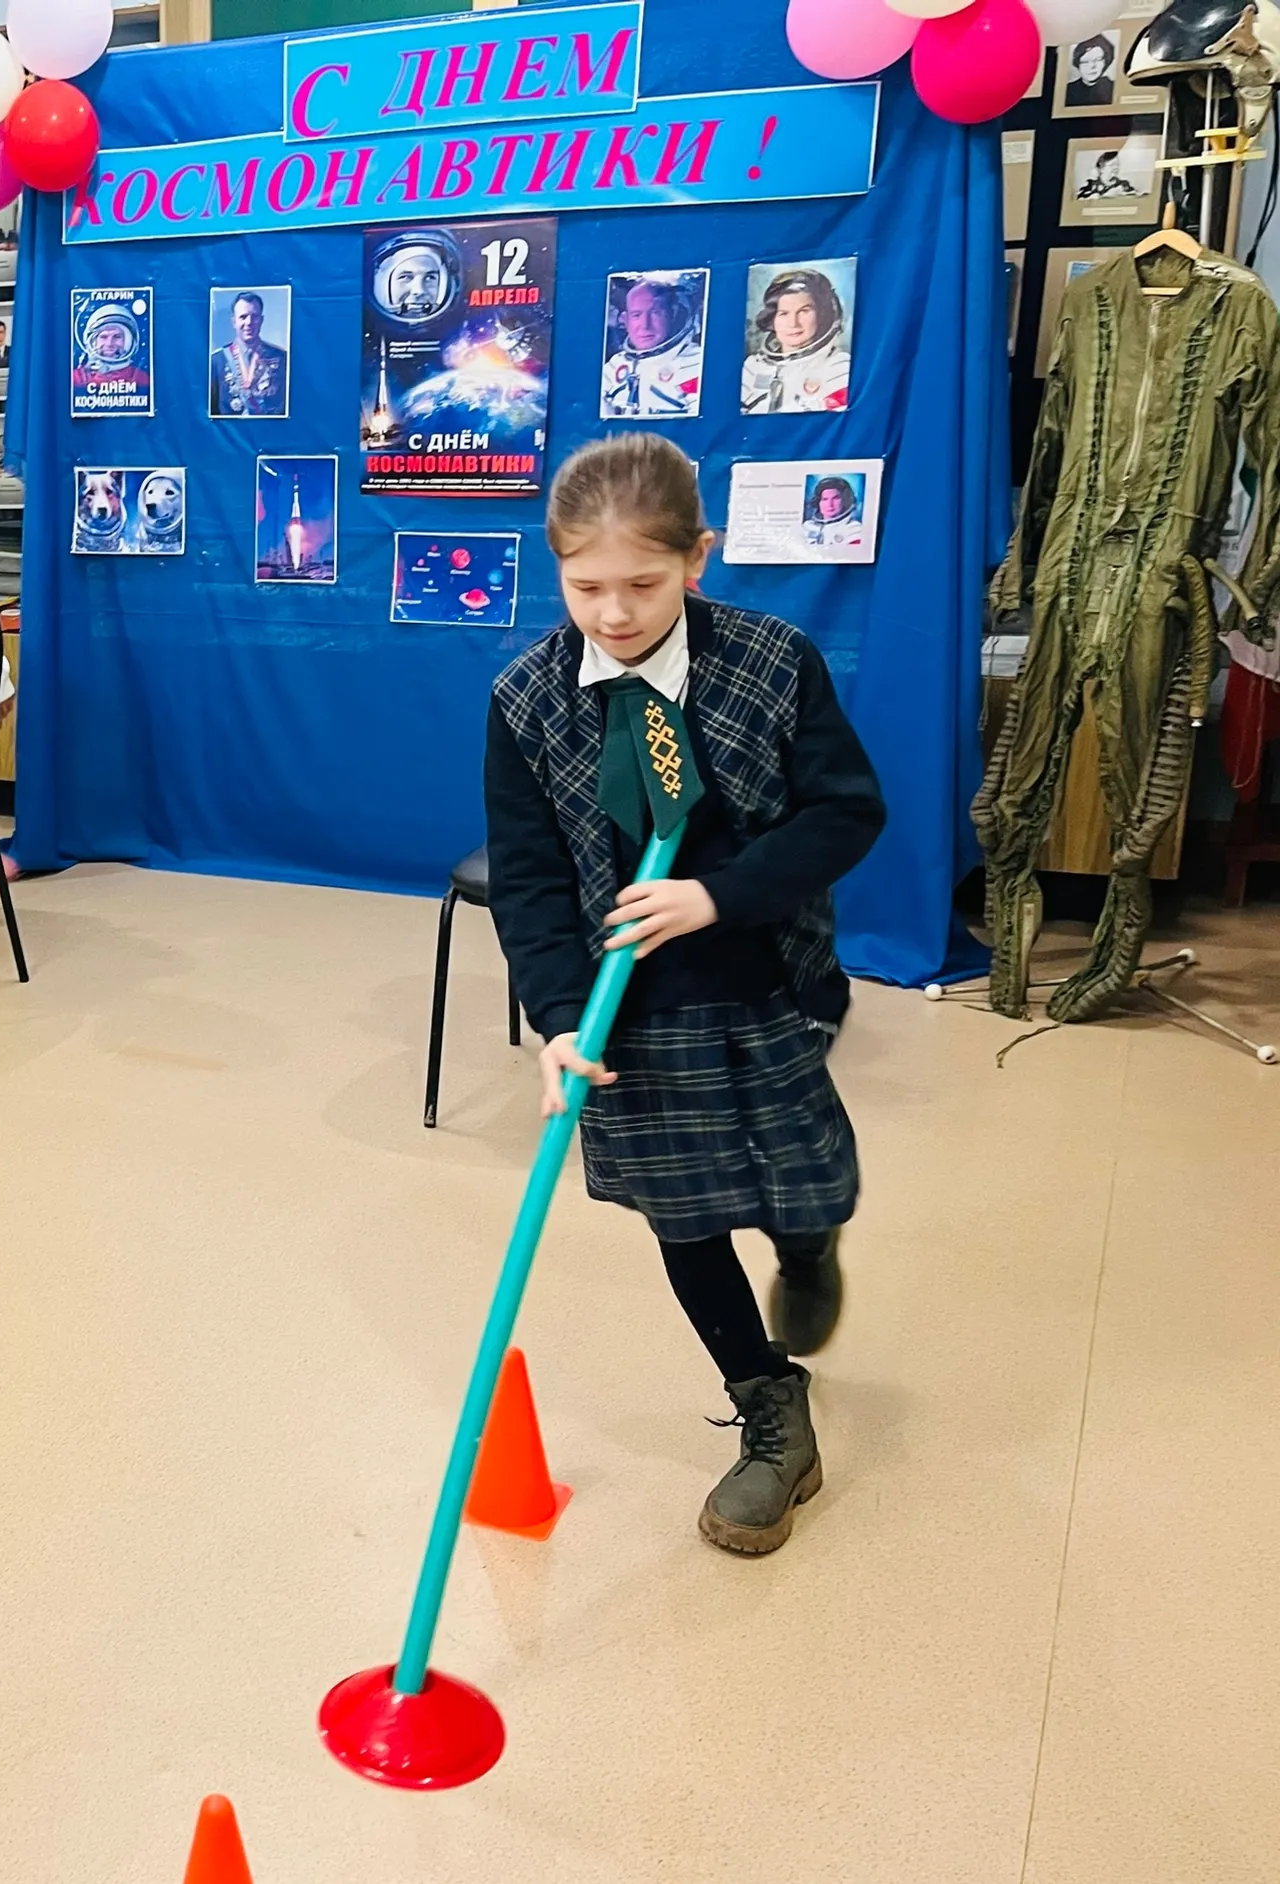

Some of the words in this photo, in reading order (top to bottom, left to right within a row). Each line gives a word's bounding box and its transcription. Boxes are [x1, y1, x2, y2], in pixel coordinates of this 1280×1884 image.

[291, 64, 350, 139] С
[379, 28, 638, 122] ДНЕМ
[66, 118, 724, 229] КОСМОНАВТИКИ
[480, 238, 529, 287] 12
[90, 291, 134, 301] ГАГАРИН
[469, 287, 540, 307] АПРЕЛЯ
[86, 382, 97, 394] С
[98, 379, 137, 395] ДНЁМ
[74, 395, 148, 408] КОСМОНАВТИКИ
[408, 433, 423, 450] С
[427, 430, 489, 453] ДНЁМ
[366, 454, 535, 474] КОСМОНАВТИКИ
